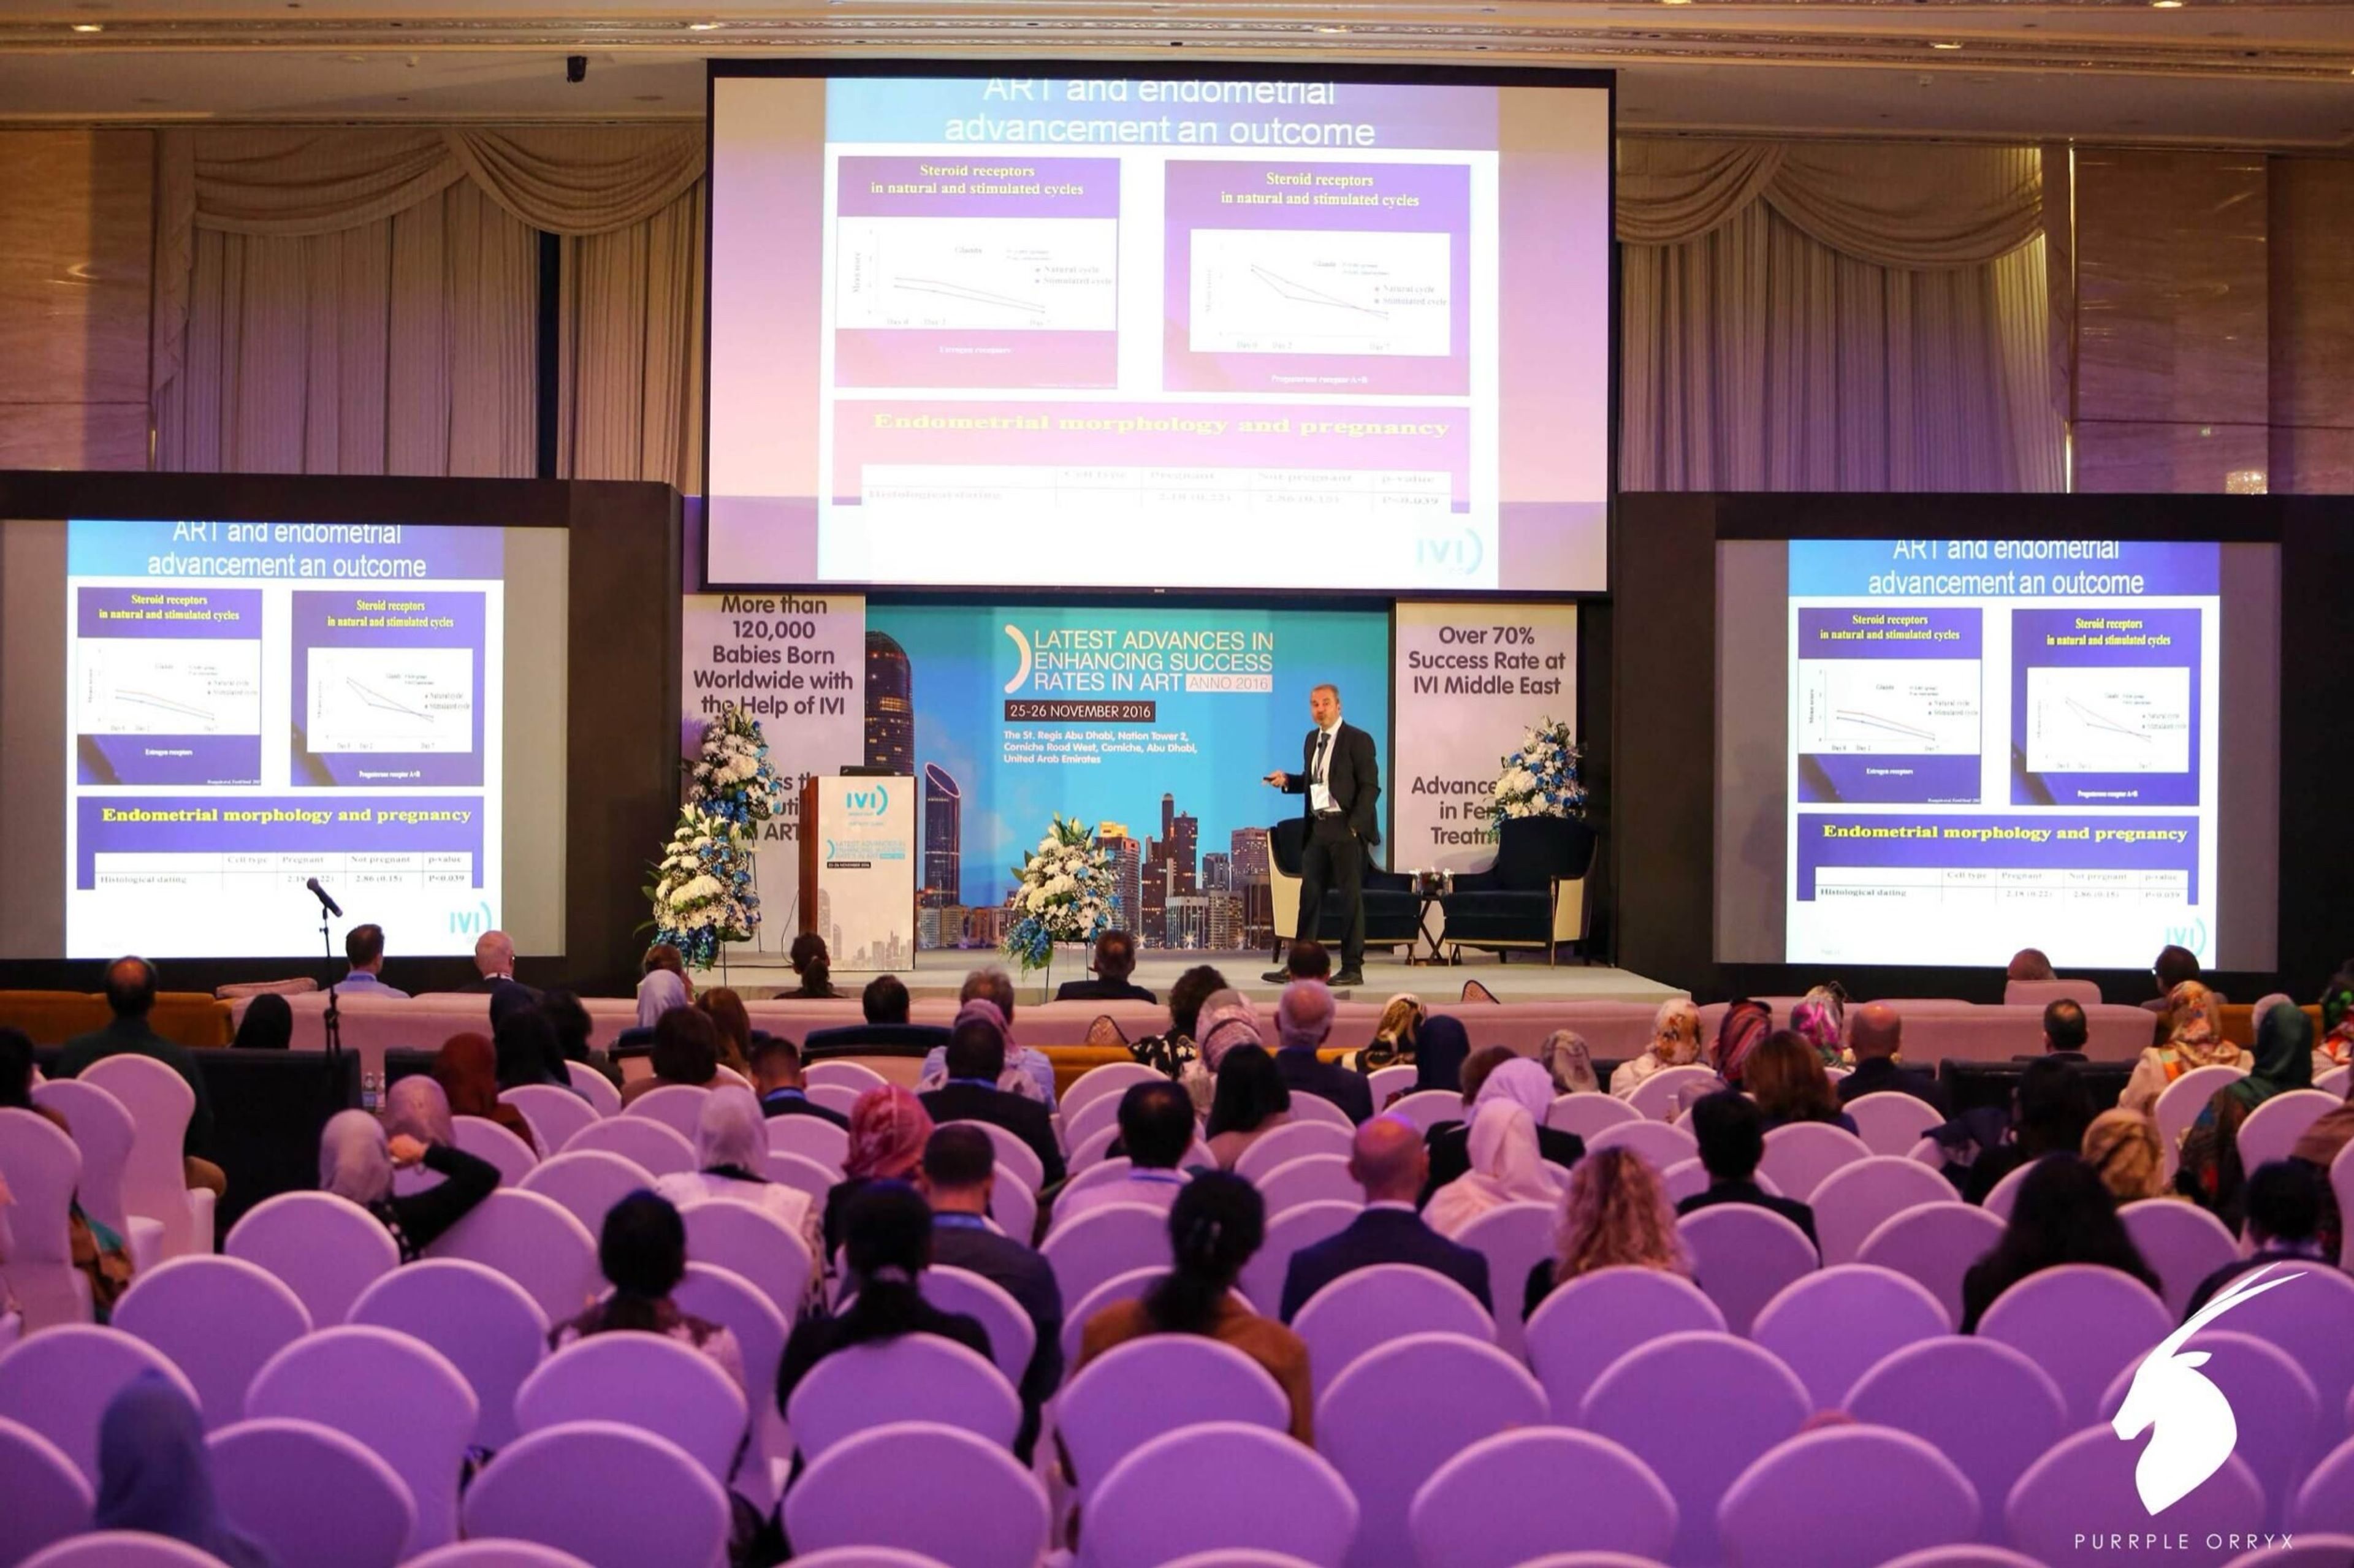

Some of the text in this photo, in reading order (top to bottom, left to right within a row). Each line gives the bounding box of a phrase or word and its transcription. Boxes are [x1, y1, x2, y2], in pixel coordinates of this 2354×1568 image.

[1067, 80, 1127, 102] and
[1139, 82, 1334, 104] endometrial
[945, 114, 1374, 145] advancement an outcome
[920, 164, 1035, 180] Steroid receptors
[1267, 172, 1373, 189] Steroid receptors
[871, 182, 1083, 197] in natural and stimulated cycles
[1221, 191, 1419, 208] in natural and stimulated cycles
[874, 414, 1450, 437] Endometrial morphology and pregnancy
[228, 523, 267, 542] and
[275, 524, 400, 544] endometrial
[148, 552, 426, 577] advancement an outcome
[1869, 570, 2144, 594] advancement an outcome
[132, 595, 207, 606] Steroid receptors
[356, 600, 425, 614] Steroid receptors
[722, 595, 828, 614] More than
[99, 609, 240, 622] in natural and stimulated cycles
[327, 616, 454, 630] in natural and stimulated cycles
[1853, 615, 1927, 626] Steroid receptors
[733, 620, 816, 642] 120,000
[2076, 618, 2142, 631] Steroid receptors
[1034, 630, 1273, 651] LATEST ADVANCES IN
[1439, 626, 1534, 645] Over 70%
[1821, 630, 1960, 641] in natural and stimulated cycles
[2047, 634, 2171, 648] in natural and stimulated cycles
[713, 645, 835, 664] Babies Born
[1035, 652, 1273, 672] ENHANCING SUCCESS
[1409, 651, 1566, 670] Success Rate at
[693, 669, 853, 690] Worldwide with
[1034, 673, 1269, 691] RATES IN ART ANNO 2016
[1414, 676, 1561, 695] IVI Middle East
[701, 695, 845, 718] the Help of IVI
[1010, 705, 1151, 718] 25-26 NOVEMBER 2016
[1004, 731, 1020, 740] The
[1023, 731, 1036, 740] St.
[1038, 731, 1062, 742] Regis
[1065, 731, 1083, 740] Abu
[1086, 731, 1114, 742] Dhabi,
[1118, 732, 1149, 740] Nation
[1152, 732, 1175, 740] Tower
[1004, 743, 1198, 753] Corniche Road West, Corniche, Abu Dhabi,
[1004, 755, 1101, 763] United Arab Emirates
[103, 809, 471, 824] Endometrial morphology and pregnancy
[1439, 802, 1457, 819] in
[1823, 825, 2187, 842] Endometrial morphology and pregnancy
[369, 856, 411, 866] pregnant
[101, 875, 187, 885] Histological dating
[1820, 888, 1906, 898] Histological dating
